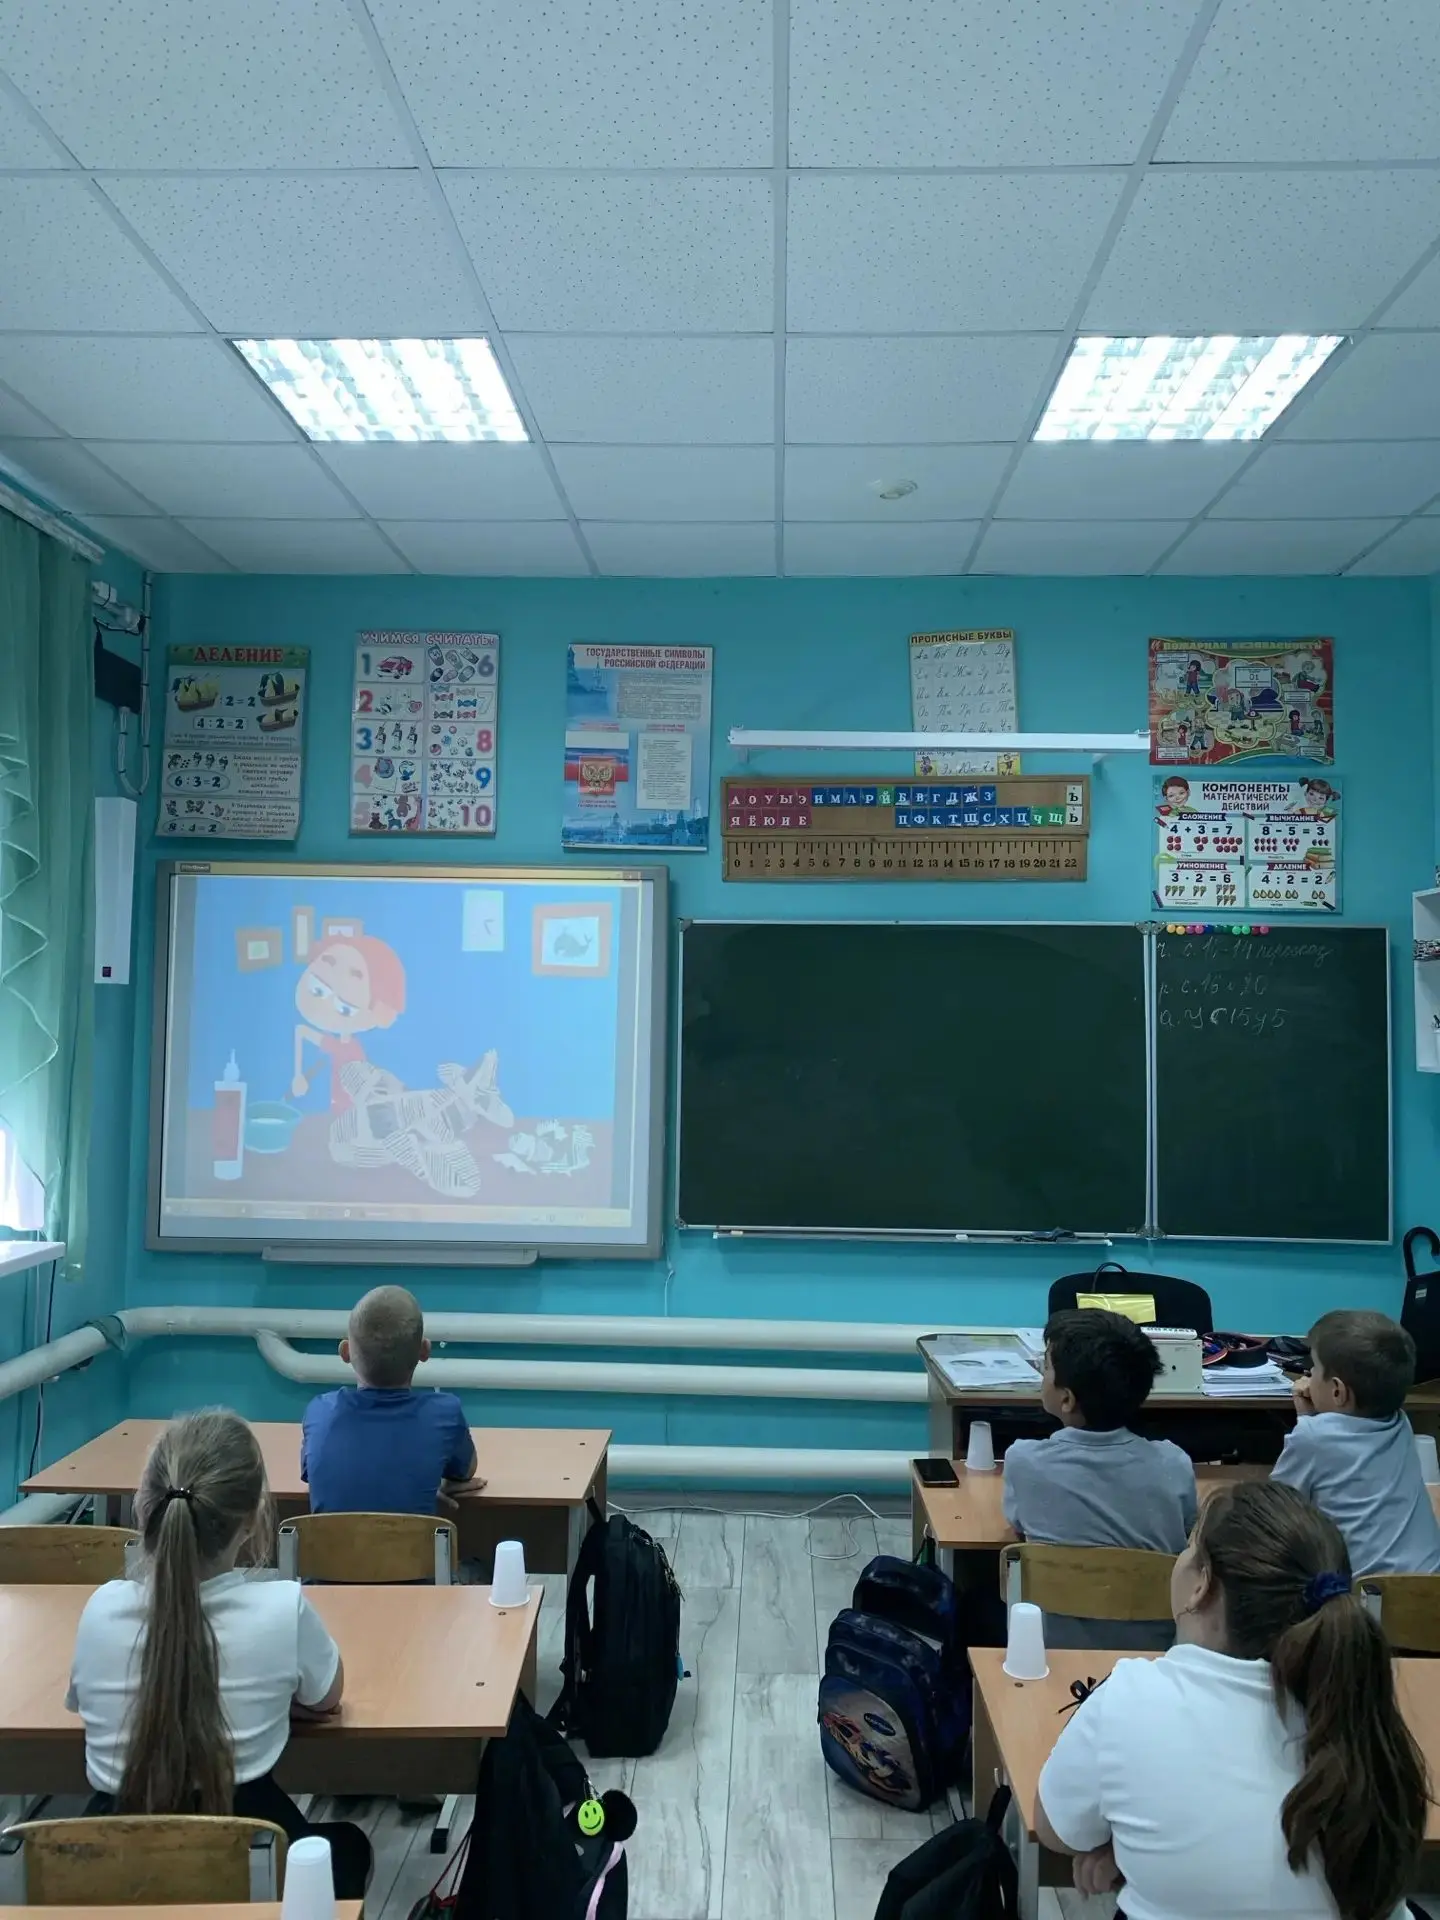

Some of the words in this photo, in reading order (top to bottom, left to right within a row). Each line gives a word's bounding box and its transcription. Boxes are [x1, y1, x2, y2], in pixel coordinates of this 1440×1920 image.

[360, 633, 420, 645] УЧИМСЯ
[425, 634, 494, 645] СЧИТАТЬ!
[911, 632, 974, 644] ПРОПИСНЫЕ
[978, 631, 1012, 640] БУКВЫ
[194, 647, 284, 662] ДЕЛЕНИЕ
[586, 648, 662, 659] ГОСУДАРСТВЕННЫЕ
[664, 649, 705, 659] СИМВОЛЫ
[361, 654, 371, 676] 1
[478, 655, 494, 677] 6
[604, 657, 656, 669] РОССИЙСКОЙ
[659, 659, 705, 671] ФЕДЕРАЦИИ
[359, 690, 373, 713] 2
[477, 691, 494, 715] 7
[356, 727, 373, 750] 3
[476, 729, 492, 753] 8
[476, 767, 492, 789] 9
[1202, 783, 1290, 792] КОМПОНЕНТЫ
[730, 796, 740, 805] А
[749, 795, 756, 804] О
[764, 795, 773, 804] У
[780, 795, 793, 804] Ы
[799, 795, 806, 804] Э
[830, 795, 841, 803] М
[847, 795, 857, 803] Л
[865, 795, 874, 803] Р
[881, 791, 891, 803] Й
[898, 792, 907, 802] Б
[916, 793, 924, 802] В
[933, 793, 941, 802] Г
[947, 792, 958, 803] Д
[964, 792, 978, 803] Ж
[984, 792, 991, 801] З
[1203, 793, 1288, 801] МАТЕМАТИЧЕСКИХ
[1221, 801, 1270, 811] ДЕЙСТВИЙ
[461, 804, 491, 827] 10
[731, 817, 740, 826] Я
[749, 815, 756, 826] Ё
[764, 817, 775, 825] Ю
[782, 816, 790, 825] И
[799, 816, 807, 825] Е
[899, 815, 907, 825] П
[914, 814, 925, 824] Ф
[932, 815, 941, 825] К
[948, 814, 958, 824] Т
[983, 814, 991, 823] С
[1000, 814, 1010, 824] Х
[1017, 813, 1027, 824] Ц
[1033, 814, 1042, 824] Ч
[1170, 825, 1178, 833] 4
[1198, 825, 1205, 834] 3
[1226, 826, 1233, 835] 7
[1262, 826, 1270, 836] 8
[1289, 826, 1296, 836] 5
[1317, 826, 1325, 836] 3
[735, 859, 740, 867] 0
[749, 859, 754, 867] 1
[765, 859, 770, 867] 2
[779, 859, 785, 868] 3
[793, 859, 800, 867] 4
[809, 858, 814, 867] 5
[823, 859, 829, 867] 6
[839, 858, 845, 867] 7
[854, 858, 860, 867] 8
[869, 859, 875, 867] 9
[884, 859, 892, 868] 10
[898, 860, 906, 868] 11
[913, 860, 923, 868] 12
[928, 860, 938, 868] 13
[943, 860, 953, 868] 14
[959, 859, 969, 867] 15
[974, 860, 984, 868] 16
[990, 860, 999, 868] 17
[1004, 860, 1015, 868] 18
[1019, 859, 1030, 868] 19
[1033, 859, 1046, 868] 20
[1049, 859, 1060, 868] 21
[1064, 859, 1076, 868] 22
[1178, 862, 1225, 870] УМНОЖЕНИЕ
[1172, 873, 1179, 882] 3
[1195, 873, 1203, 883] 2
[1223, 874, 1231, 883] 6
[1262, 874, 1270, 884] 4
[1287, 875, 1294, 884] 2
[1315, 875, 1323, 884] 2
